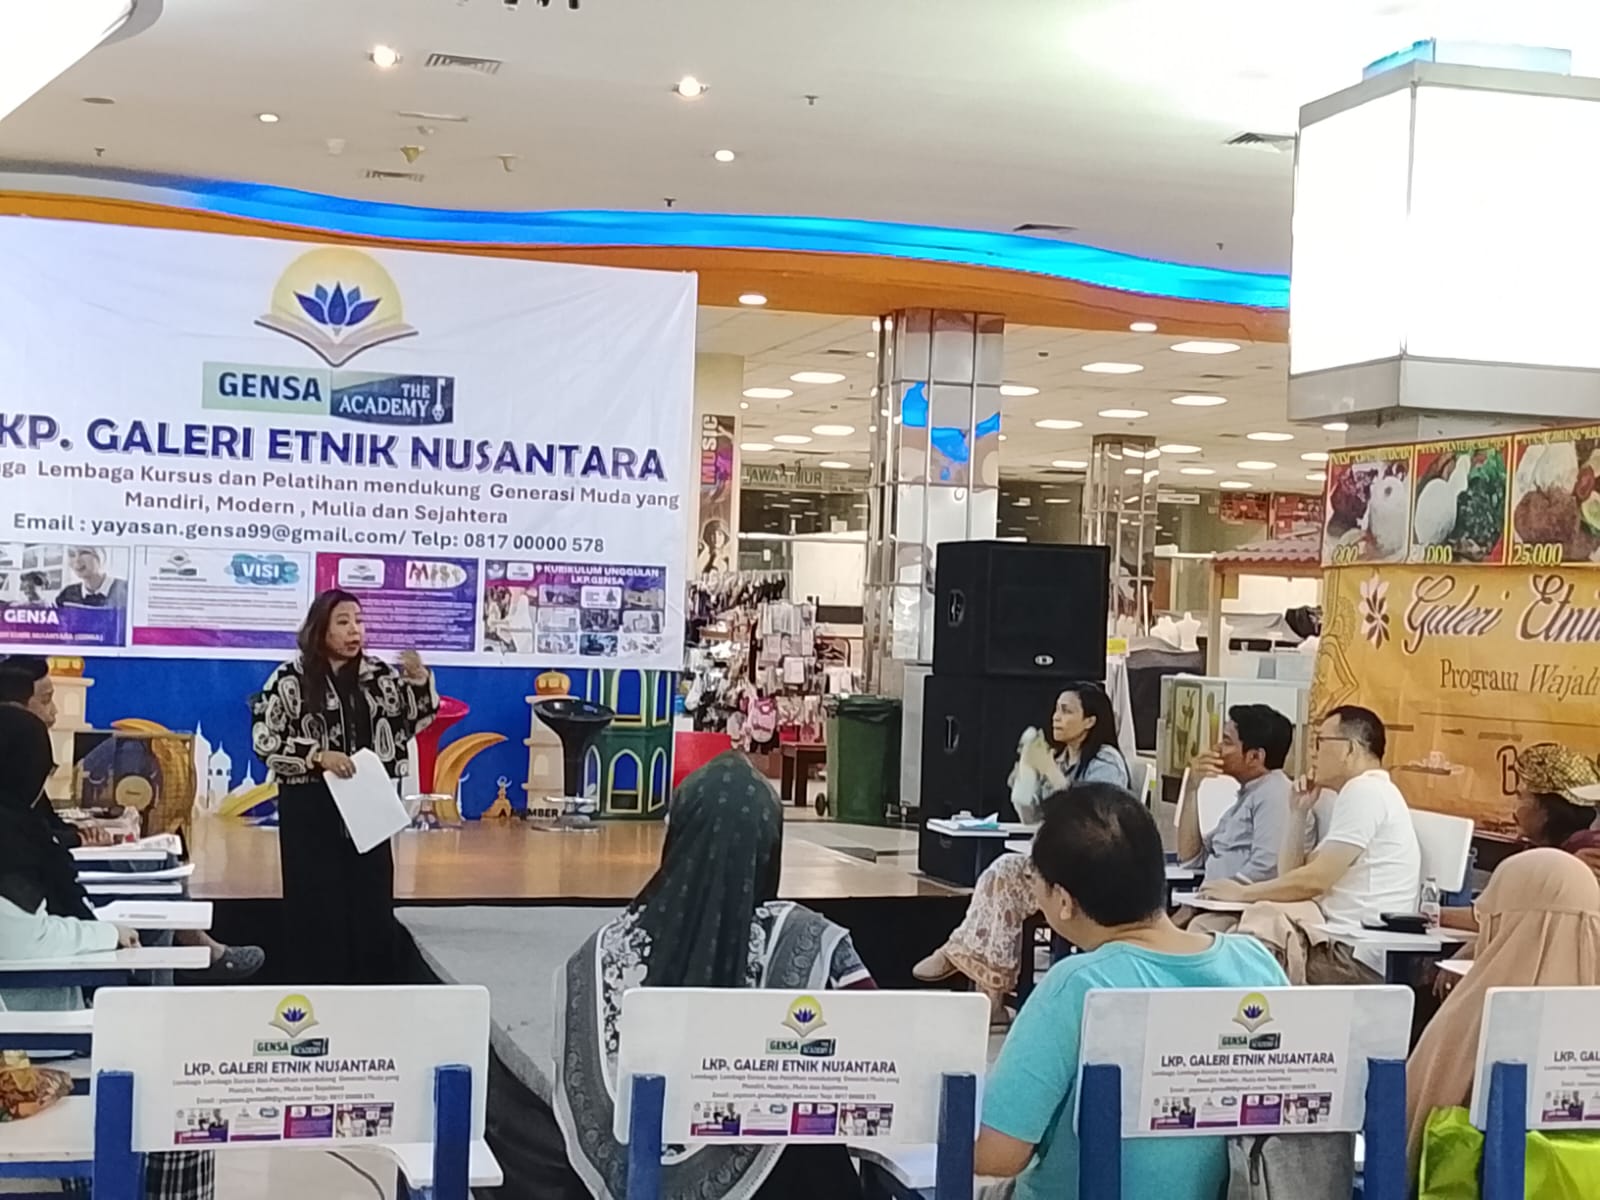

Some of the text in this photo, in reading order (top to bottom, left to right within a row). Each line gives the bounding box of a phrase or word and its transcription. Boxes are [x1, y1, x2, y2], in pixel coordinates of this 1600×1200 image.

[219, 372, 322, 402] GENSA
[401, 383, 431, 399] THE
[339, 395, 429, 417] ACADEMY
[87, 418, 255, 461] GALERI
[267, 428, 399, 468] ETNIK
[411, 436, 668, 482] NUSANTARA
[701, 415, 718, 484] MUSIC
[0, 460, 680, 510] ga Lembaga Kursus dan Pelatihan mendukung Generasi Muda yang
[125, 491, 210, 512] Mandiri,
[217, 495, 294, 515] Modern
[312, 500, 367, 518] Mulia
[372, 504, 408, 520] dan
[415, 505, 508, 525] Sejahtera
[13, 513, 74, 531] Email
[412, 531, 459, 550] Telp:
[463, 533, 508, 550] 0817
[513, 535, 566, 551] 00000
[572, 537, 604, 552] 578
[242, 563, 280, 579] VISI
[544, 565, 602, 575] KURIKULUM
[605, 567, 659, 578] UNGGULAN
[4, 609, 60, 625] GENSA
[1402, 575, 1511, 655] Galeri
[1440, 658, 1519, 696] Program
[510, 807, 559, 819] MBER
[257, 1041, 288, 1052] GENSA
[769, 1040, 799, 1051] GENSA
[1161, 1052, 1335, 1067] LKP. GALERI ETNIK NUSANTARA
[1553, 1050, 1577, 1062] LKP.
[184, 1058, 396, 1076] LKP. GALERI ETNIK NUSANTARA
[702, 1058, 896, 1074] LKP. GALERI ETNIK NUSANTARA
